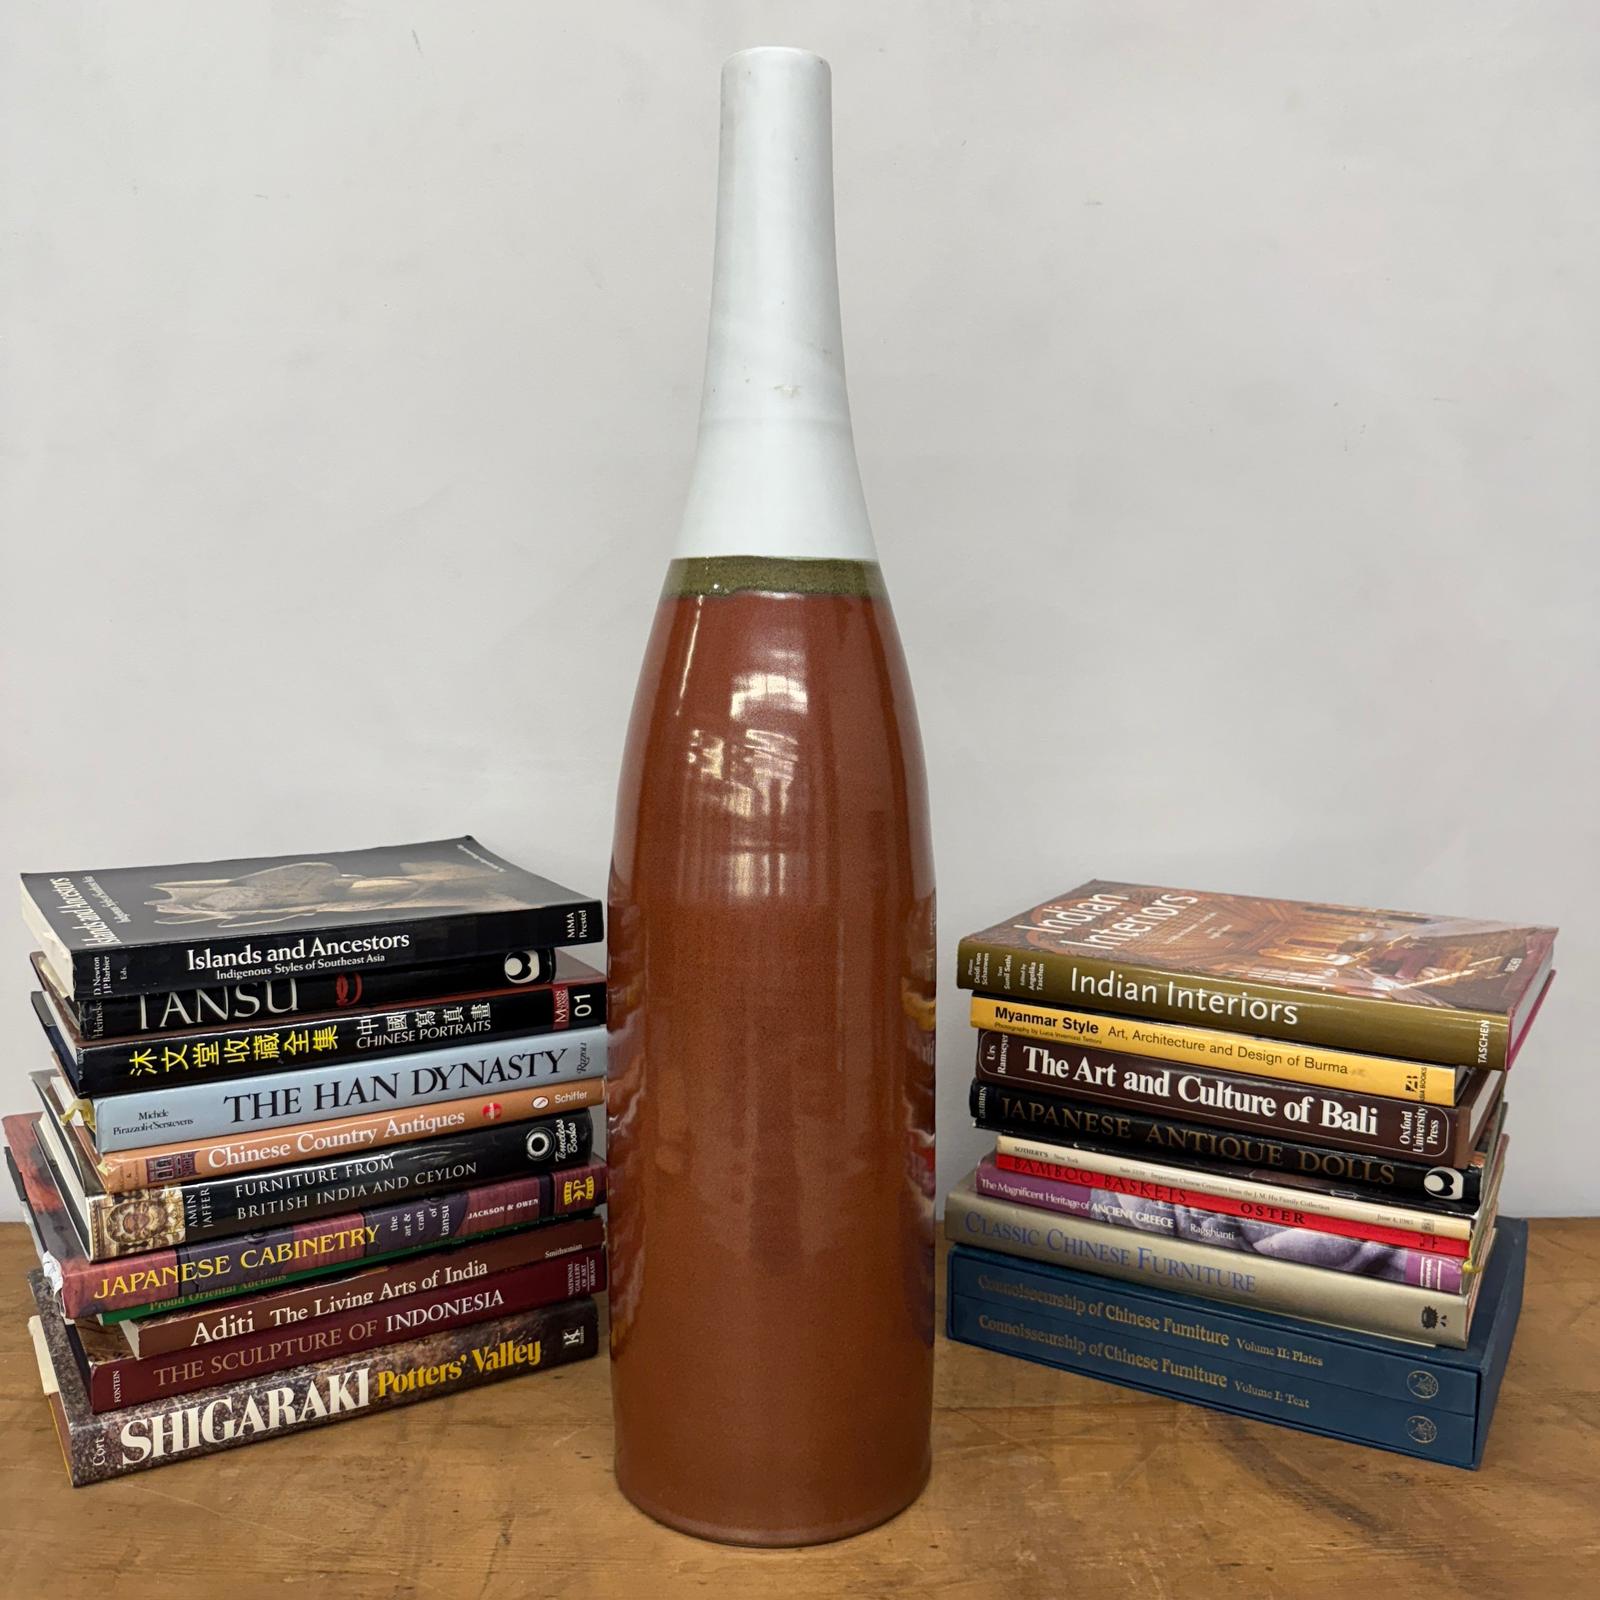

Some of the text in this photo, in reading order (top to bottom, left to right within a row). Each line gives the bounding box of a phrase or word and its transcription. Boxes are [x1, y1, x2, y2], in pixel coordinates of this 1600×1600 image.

[566, 912, 575, 938] MMA
[578, 909, 588, 938] Prestel
[1014, 893, 1129, 935] Indian
[1060, 893, 1199, 950] Interiors
[92, 956, 102, 986] Newton
[103, 955, 111, 982] Barbier
[187, 933, 411, 971] Islands and Ancestors
[217, 953, 386, 980] Indigenous Styles of Southeast Asia
[573, 993, 592, 1018] 01
[1072, 967, 1298, 1025] Indian Interiors
[356, 1019, 492, 1050] CHINESE PORTRAITS
[995, 1006, 1348, 1075] Myanmar Style Art, Architecture and Design of Burma
[1478, 1019, 1490, 1064] TASCHEN
[224, 1048, 568, 1124] THE HAN DYNASTY
[555, 1089, 588, 1105] Schiffer
[1023, 1045, 1379, 1136] The Art and Culture of Bali
[208, 1112, 465, 1169] Chinese Country Antiques
[1002, 1096, 1396, 1185] JAPANESE ANTIQUE DOLLS
[1400, 1110, 1412, 1145] Oxford
[1413, 1105, 1428, 1153] University
[1427, 1119, 1440, 1145] Press
[236, 1157, 394, 1197] FURNITURE FROM
[237, 1162, 477, 1220] BRITISH INDIA AND CEYLON
[1014, 1157, 1305, 1225] BAMBOO BASKETS OSTER
[186, 1194, 198, 1228] AMIN
[201, 1187, 215, 1228] JAFFER
[390, 1215, 398, 1231] the
[403, 1213, 412, 1237] art &
[416, 1209, 425, 1231] craft
[428, 1207, 438, 1218] of
[440, 1204, 450, 1236] tansu
[467, 1198, 539, 1220] JACKSON & OWEN
[981, 1178, 1235, 1241] The Magnificent Heritage of ANCIENT GREECE Ragghianti
[94, 1224, 380, 1299] JAPANESE CABINETRY
[965, 1210, 1256, 1293] CLASSIC CHINESE FURNITURE
[190, 1260, 488, 1347] Aditi The Living Arts of India
[977, 1274, 1324, 1368] Connoisseurship of Chinese Furniture Volume II: Plates
[153, 1288, 505, 1387] THE SCULPTURE OF INDONESIA
[978, 1314, 1310, 1409] Connoisseurship of Chinese Furniture Volume I: Text
[120, 1340, 542, 1466] SHIGARAKI Potters' Valley
[92, 1436, 106, 1466] Cort
